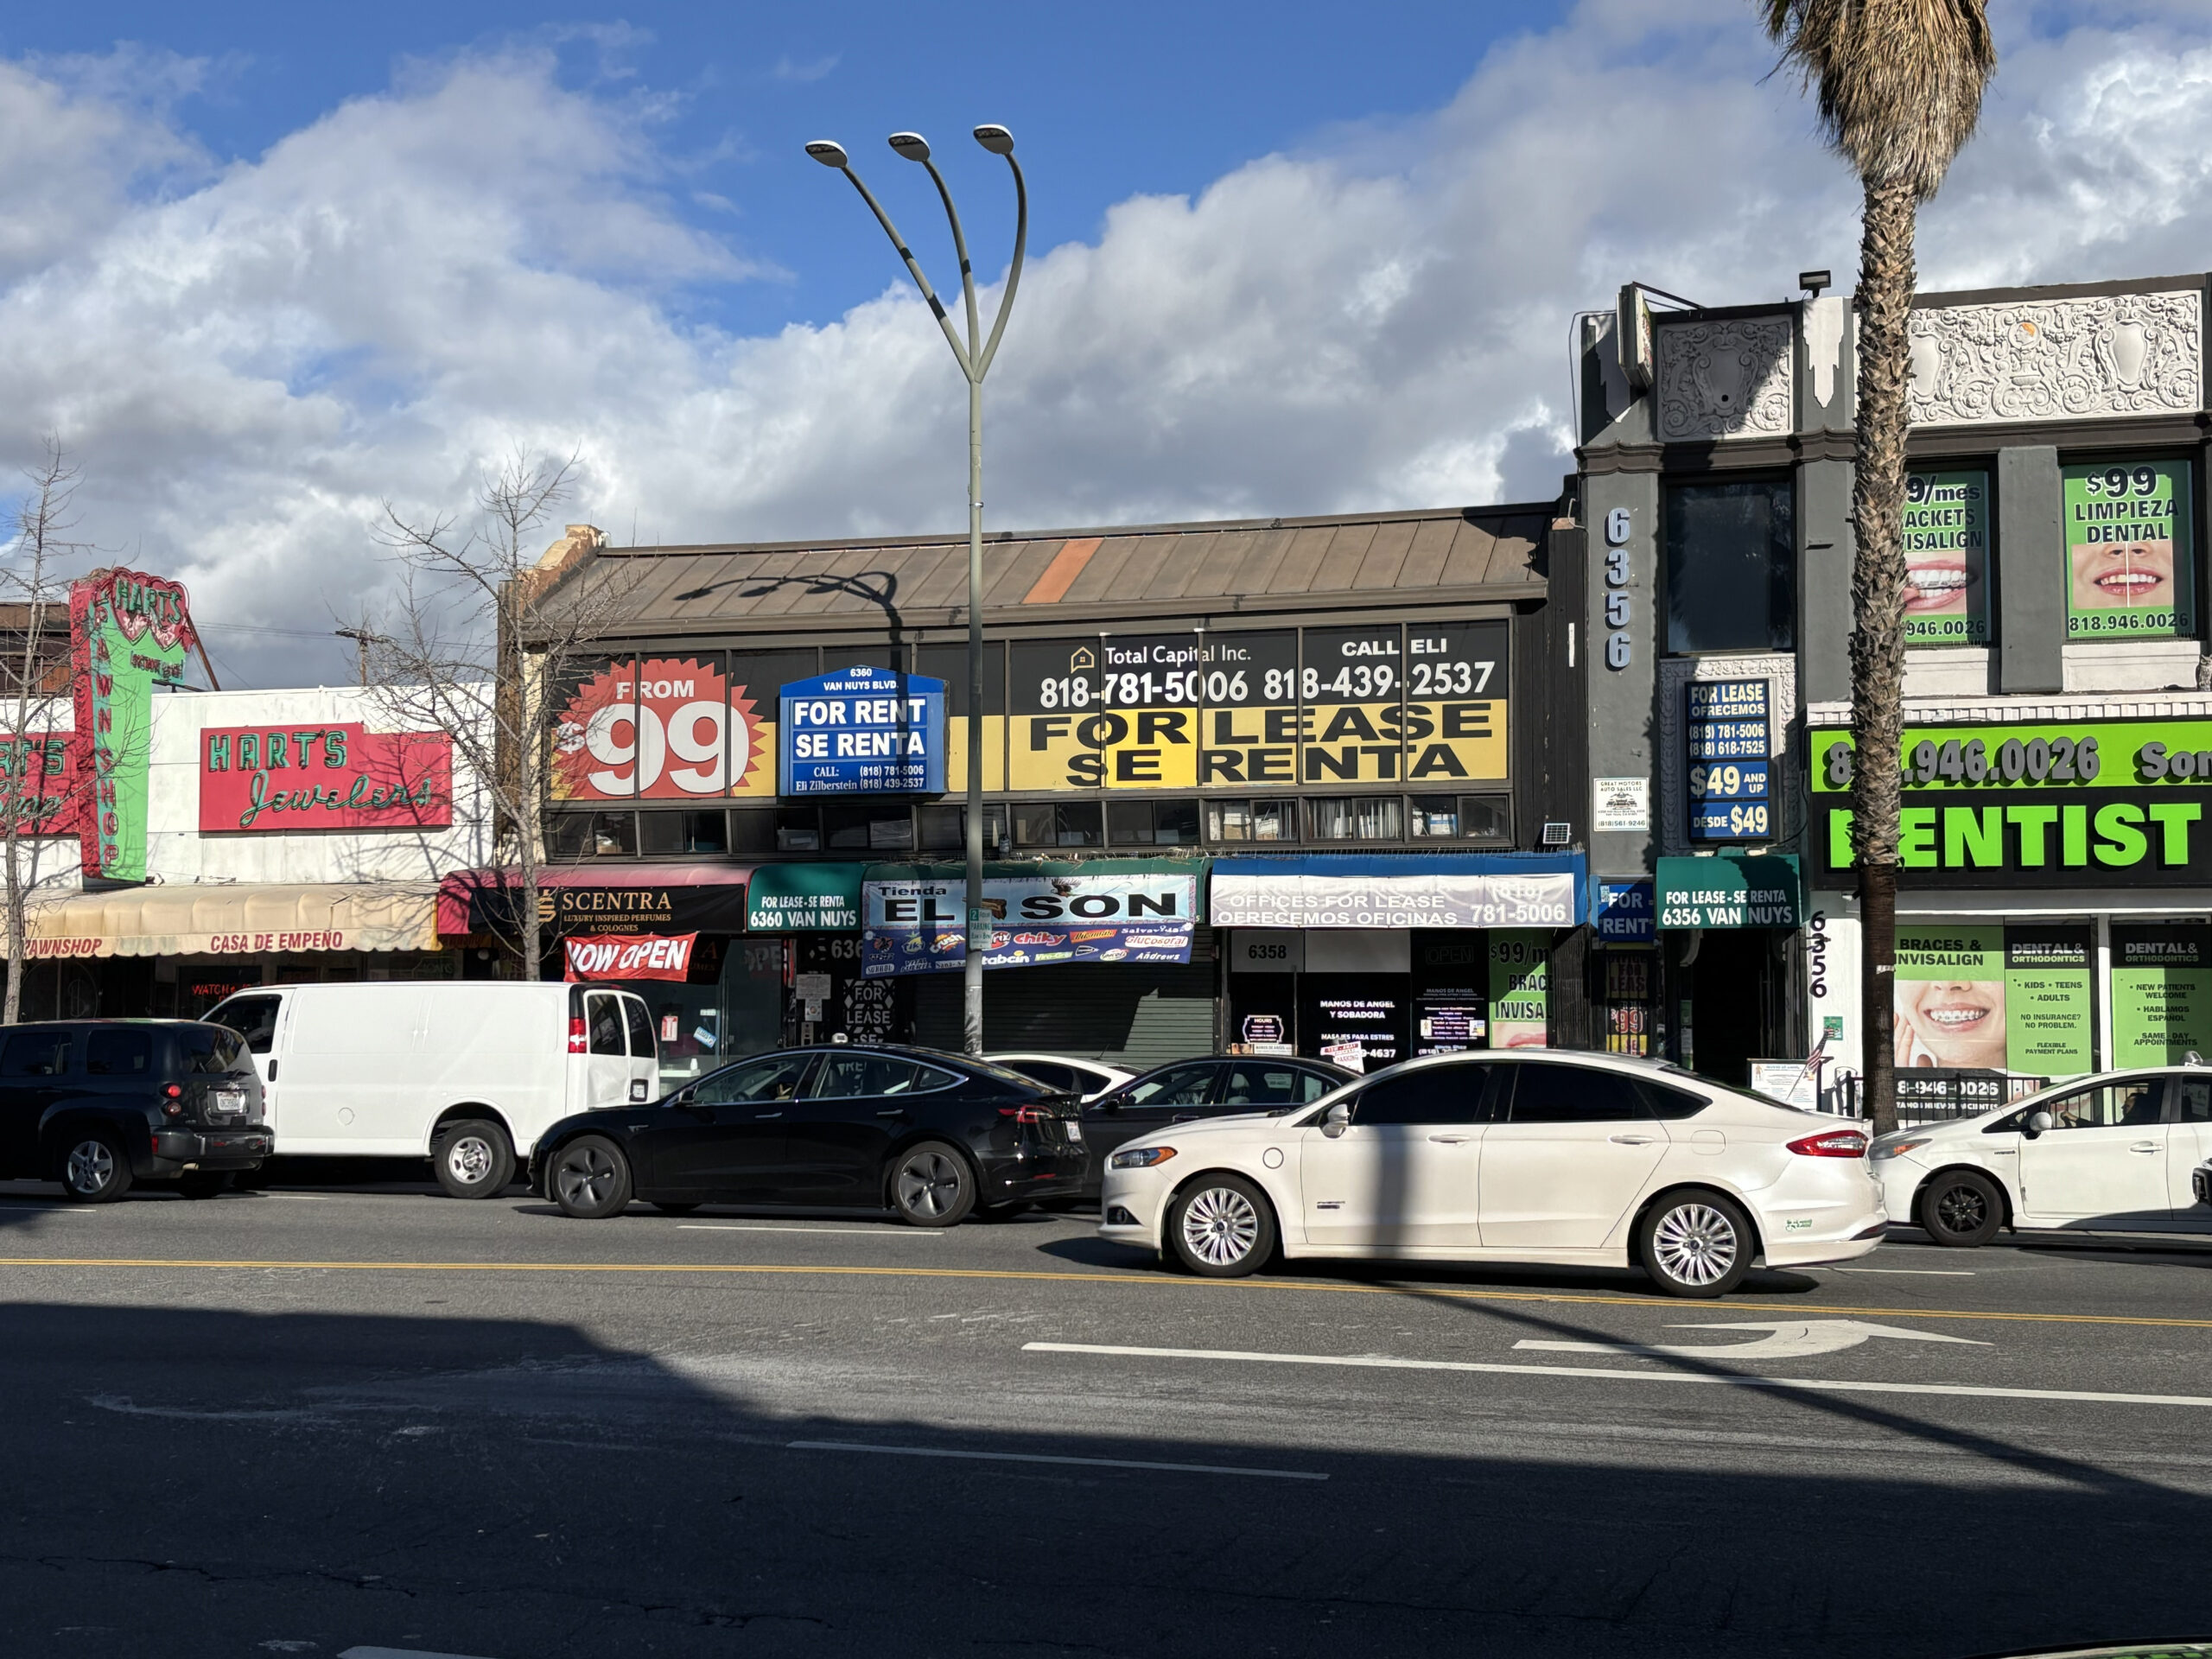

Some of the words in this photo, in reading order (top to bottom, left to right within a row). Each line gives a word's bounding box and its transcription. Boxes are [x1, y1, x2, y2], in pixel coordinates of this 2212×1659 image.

[1905, 475, 1980, 505] 9/mes
[2085, 466, 2158, 497] $99
[1904, 508, 1975, 528] ACKETS
[2075, 499, 2178, 522] LIMPIEZA
[1903, 531, 1982, 550] ISALIGN
[2086, 522, 2169, 543] DENTAL
[1606, 506, 1631, 669] 6356
[1905, 620, 1985, 637] 946.0026
[2069, 612, 2190, 632] 818.946.0026
[1105, 646, 1147, 666] Total
[1152, 645, 1215, 664] Capital
[1221, 645, 1251, 663] Inc.
[1341, 640, 1400, 657] CALL
[1410, 638, 1447, 654] ELI
[849, 668, 872, 677] 6360
[616, 680, 695, 700] FROM
[823, 682, 842, 690] VAN
[845, 681, 870, 690] NUYS
[873, 680, 899, 690] BLVD.
[1040, 670, 1248, 708] 818-781-5006
[1263, 661, 1496, 700] 818-439-2537
[1691, 685, 1718, 704] FOR
[1721, 683, 1764, 703] LEASE
[794, 700, 846, 725] FOR
[855, 699, 925, 724] RENT
[1691, 703, 1765, 717] OFRECEMOS
[1030, 710, 1192, 752] FOR
[1214, 702, 1492, 745] LEASE
[1689, 724, 1715, 738] (818)
[1718, 723, 1765, 739] 781-5006
[208, 729, 347, 772] HART'S
[556, 701, 751, 797] $99
[796, 734, 828, 758] SE
[837, 732, 925, 757] RENTA
[1689, 741, 1715, 756] (818)
[1718, 741, 1765, 755] 618-7525
[1065, 748, 1163, 787] SE
[1202, 743, 1470, 783] RENTA
[1827, 736, 2101, 785] 8.946.0026
[814, 766, 840, 777] CALL:
[860, 766, 882, 777] (818)
[884, 766, 924, 776] 781-5006
[796, 780, 807, 791] Eli
[809, 779, 857, 791] Zilberstein
[860, 779, 882, 789] (818)
[884, 778, 924, 789] 439-2537
[1690, 765, 1740, 798] $49
[1744, 773, 1766, 783] AND
[1749, 784, 1764, 793] UP
[239, 769, 431, 828] Jewelers
[1693, 816, 1728, 828] DESDE
[1730, 804, 1768, 836] $49
[562, 892, 672, 911] SCENTRA
[761, 896, 778, 908] FOR
[820, 895, 845, 907] RENTA
[878, 887, 947, 897] Tienda
[1230, 894, 1319, 908] OFFICES
[1325, 894, 1372, 908] FOR
[1375, 894, 1446, 908] LEASE
[1609, 892, 1643, 908] FOR
[1666, 891, 1688, 905] FOR
[1750, 889, 1787, 903] RENTA
[884, 898, 956, 922] EL
[1020, 893, 1177, 920] SON
[1470, 903, 1567, 924] 781-5006
[1662, 907, 1701, 926] 6356
[1706, 907, 1741, 925] VAN
[1747, 906, 1793, 924] NUYS
[750, 911, 783, 928] 6360
[788, 911, 816, 926] VAN
[821, 910, 856, 926] NUYS
[1217, 912, 1351, 925] OFRECEMOS
[1363, 912, 1458, 925] OFICINAS
[1603, 918, 1649, 934] RENT
[210, 935, 248, 951] CASA
[254, 934, 274, 950] DE
[279, 929, 343, 950] EMPEÑO
[1014, 931, 1067, 946] chiky
[1899, 938, 1964, 950] BRACES
[1969, 939, 1982, 950] &
[618, 939, 689, 970] OPEN
[831, 939, 863, 959] 636
[1248, 944, 1287, 960] 6358
[1490, 941, 1549, 967] $99/m
[1809, 910, 1827, 999] 6356
[982, 954, 1030, 965] tabcin
[2012, 955, 2085, 963] ORTHODONTICS
[1509, 974, 1554, 991] BRACE
[855, 988, 883, 1001] FOR
[846, 1011, 891, 1024] LEASE
[1495, 1001, 1553, 1019] INVISAL
